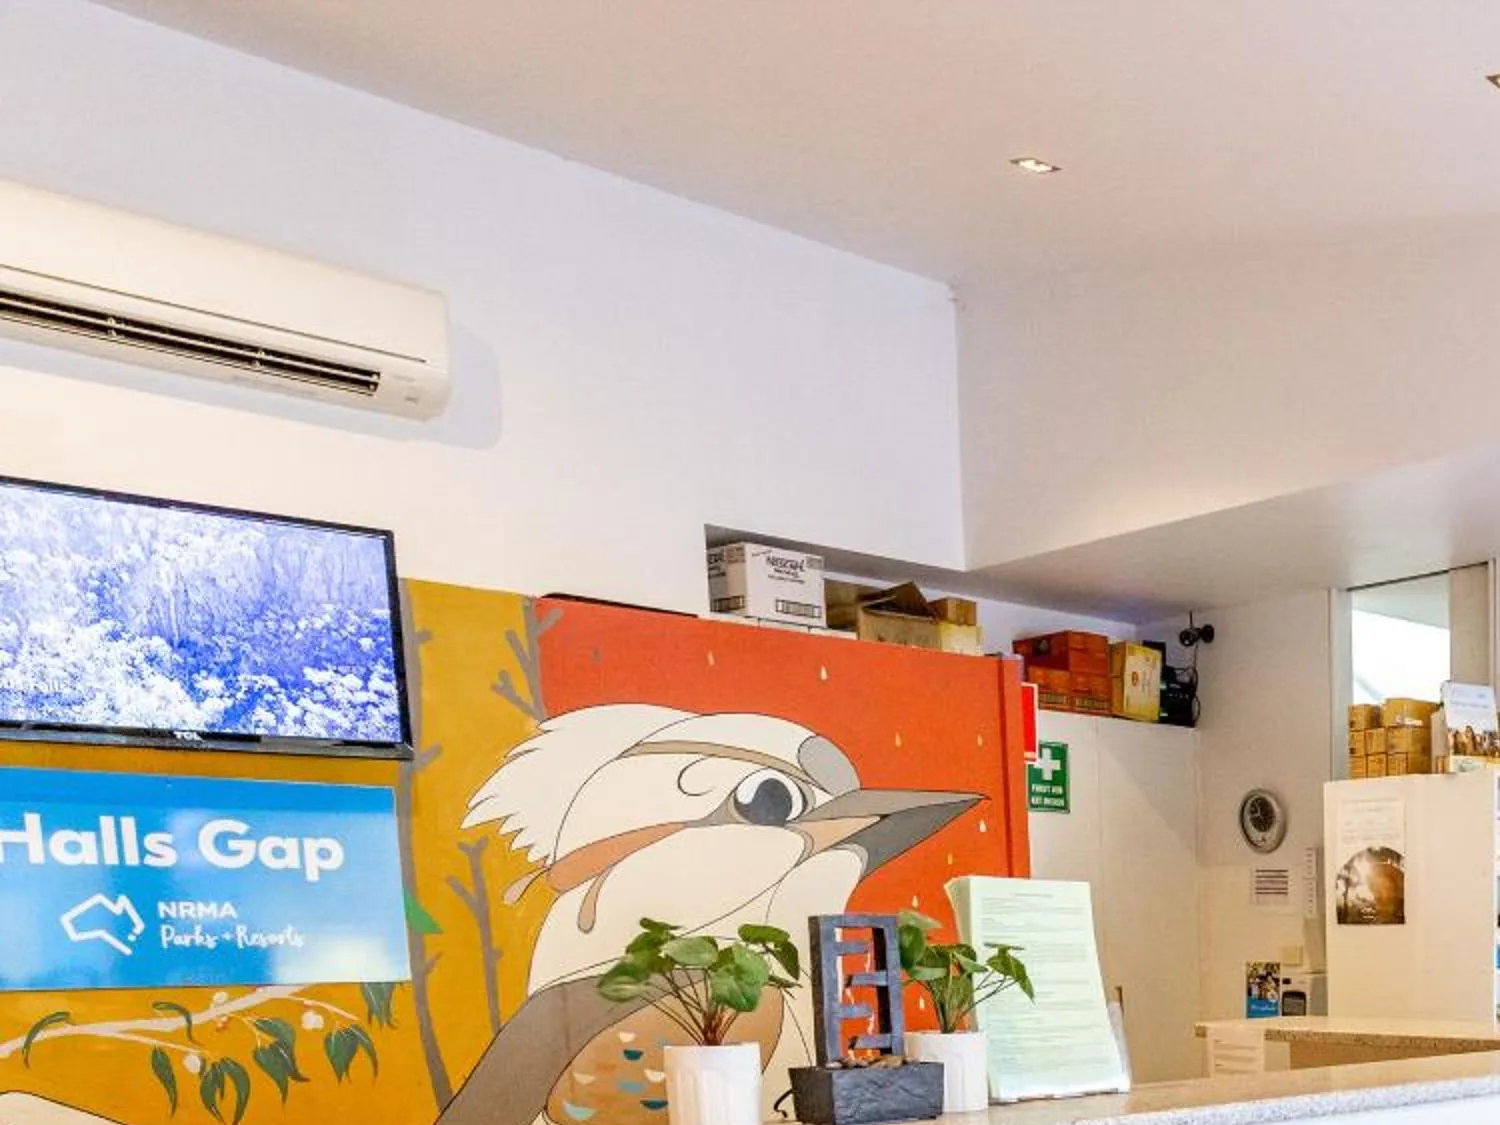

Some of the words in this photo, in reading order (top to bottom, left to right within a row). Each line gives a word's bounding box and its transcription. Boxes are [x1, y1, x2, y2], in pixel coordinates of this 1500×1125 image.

[173, 730, 204, 742] TCL
[0, 813, 178, 868] Halls
[198, 819, 345, 882] Gap
[157, 901, 238, 919] NRMA
[161, 926, 219, 949] Parks
